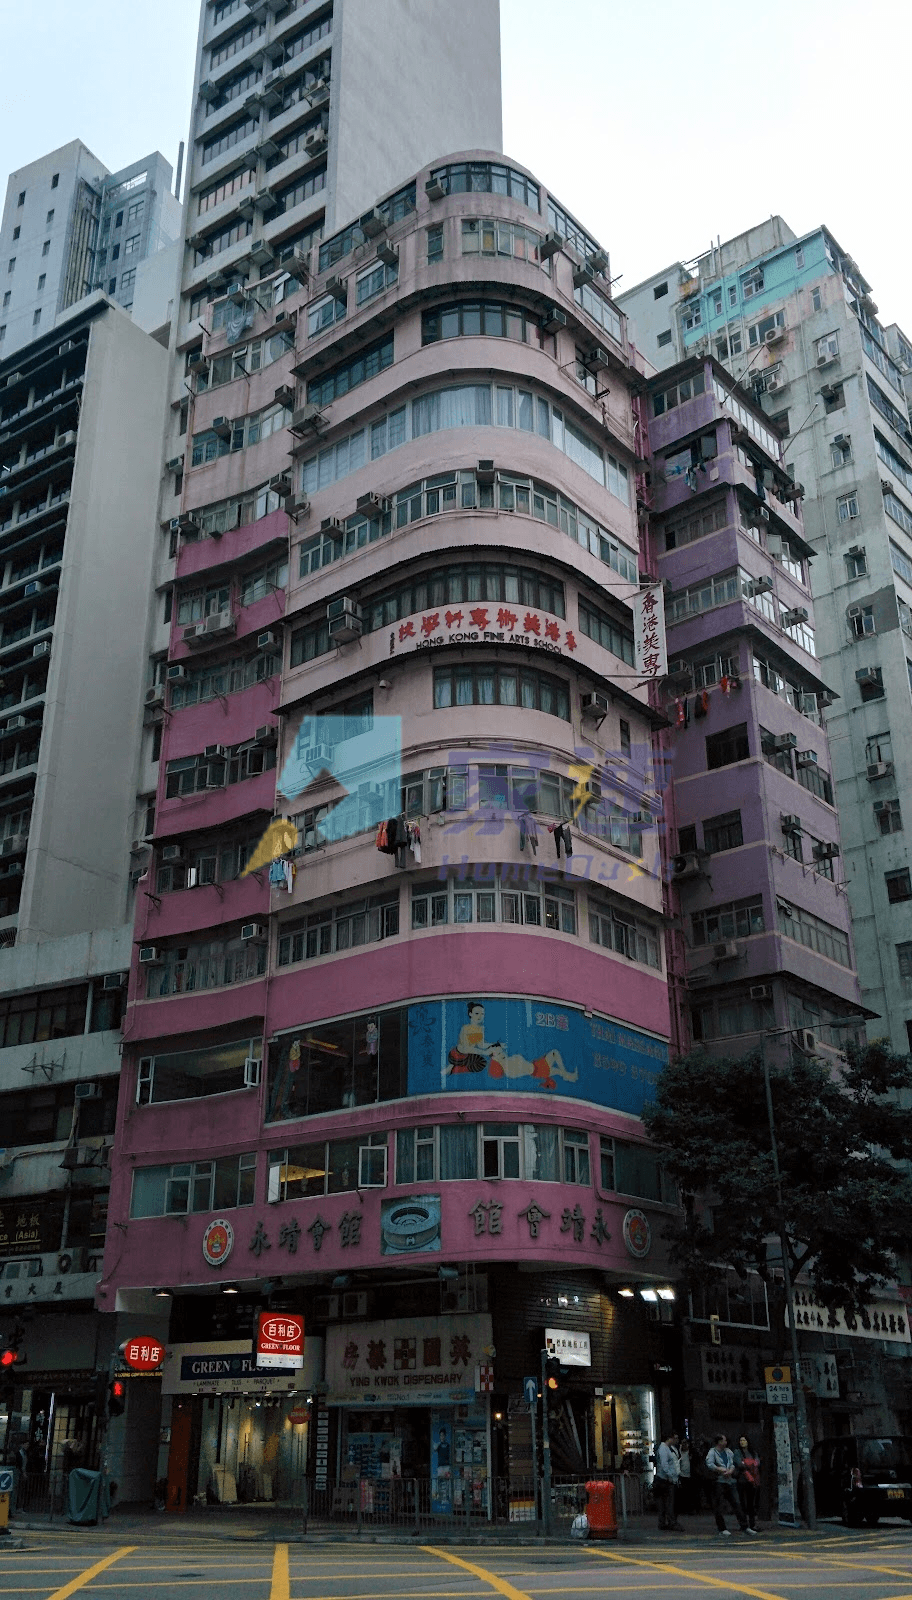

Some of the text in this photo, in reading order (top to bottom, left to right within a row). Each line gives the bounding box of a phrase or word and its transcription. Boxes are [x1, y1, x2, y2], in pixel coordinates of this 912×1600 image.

[398, 607, 578, 652] 香港美術專科學校
[641, 591, 662, 676] 香港美專
[416, 631, 563, 655] HONG KONG FINE ARTS SCHOOL
[269, 1323, 295, 1338] 百利店
[129, 1345, 160, 1362] 百利店
[261, 1342, 301, 1352] GREEN FLOOR
[191, 1360, 231, 1374] GREEN
[350, 1374, 463, 1387] YING KWOK DISPENSARY
[772, 1393, 788, 1402] 全日
